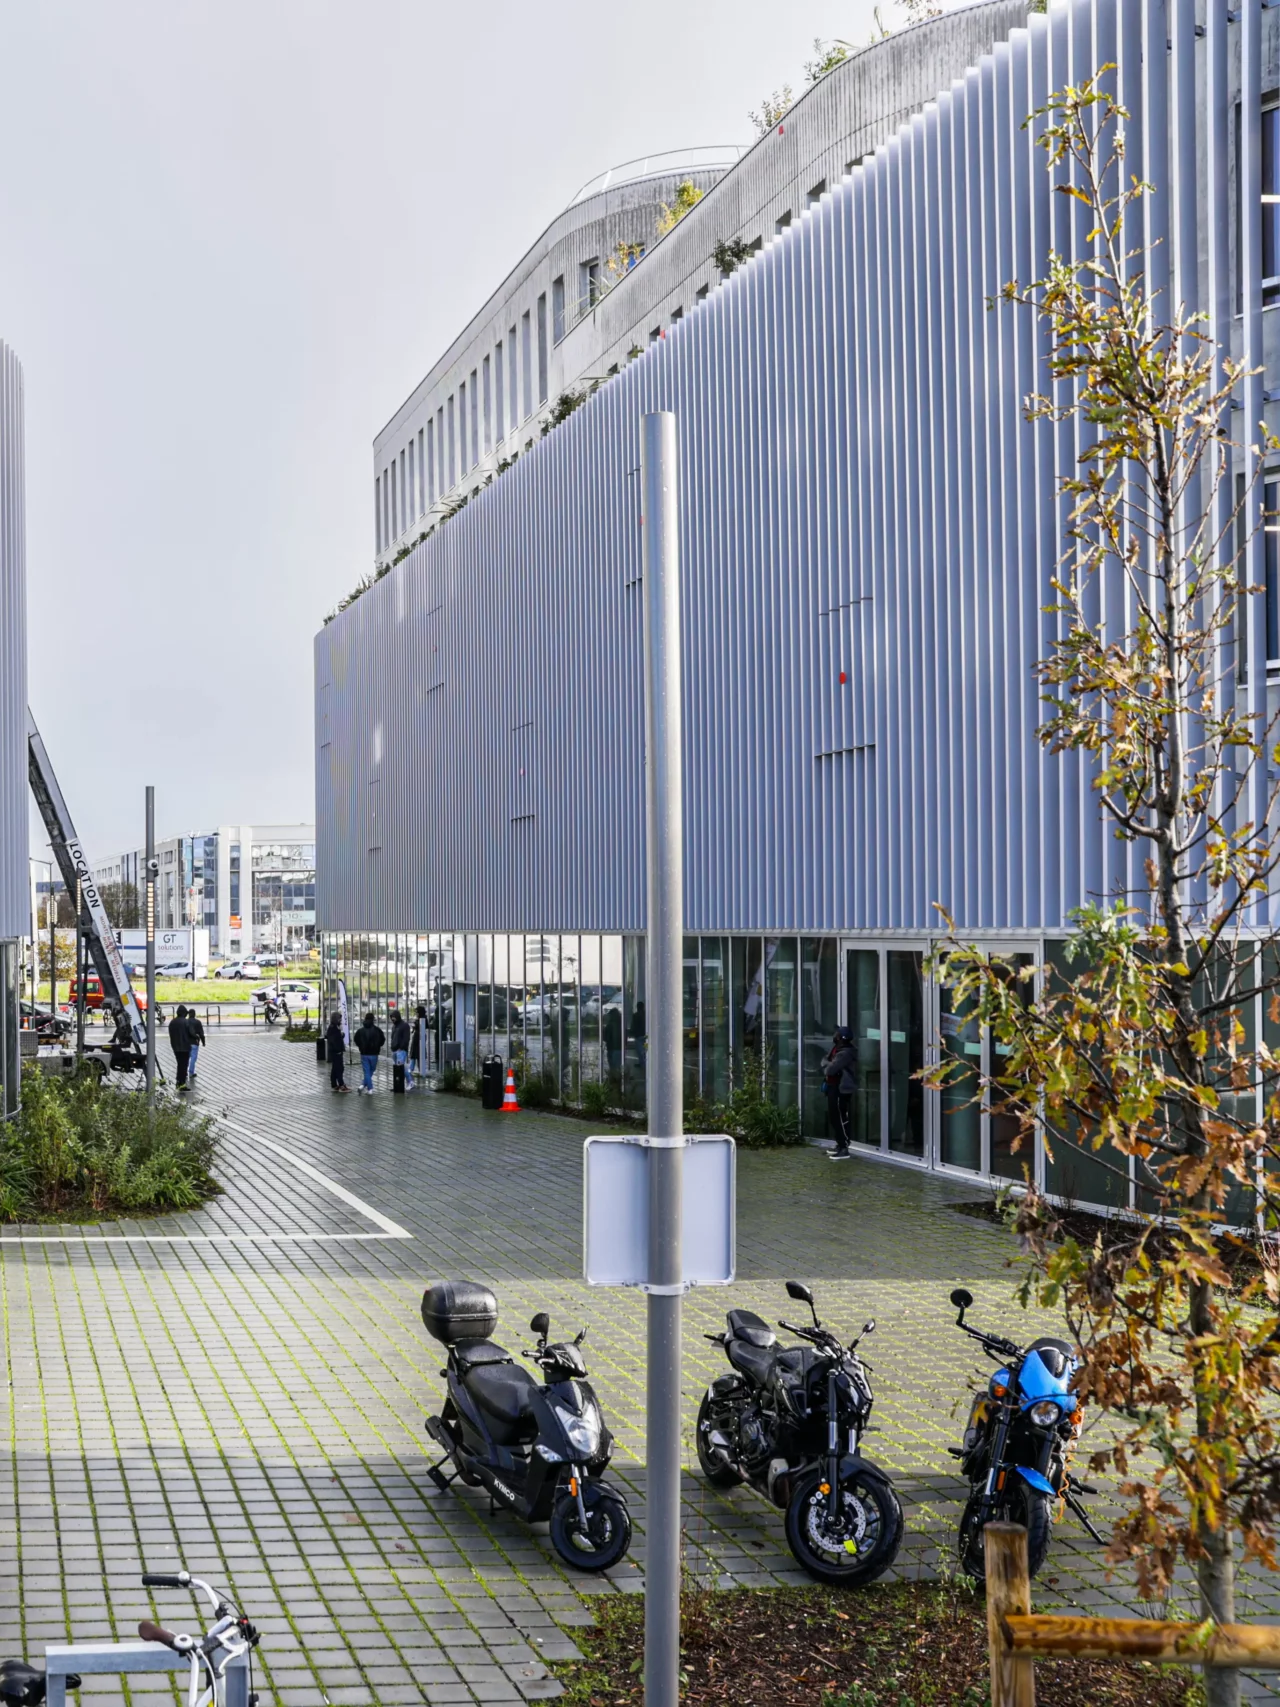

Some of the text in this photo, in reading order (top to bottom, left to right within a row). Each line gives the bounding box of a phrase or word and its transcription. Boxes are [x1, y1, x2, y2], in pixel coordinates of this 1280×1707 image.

[70, 843, 100, 908] LOCATION
[163, 934, 176, 943] GT
[493, 1478, 515, 1501] KYMCO
